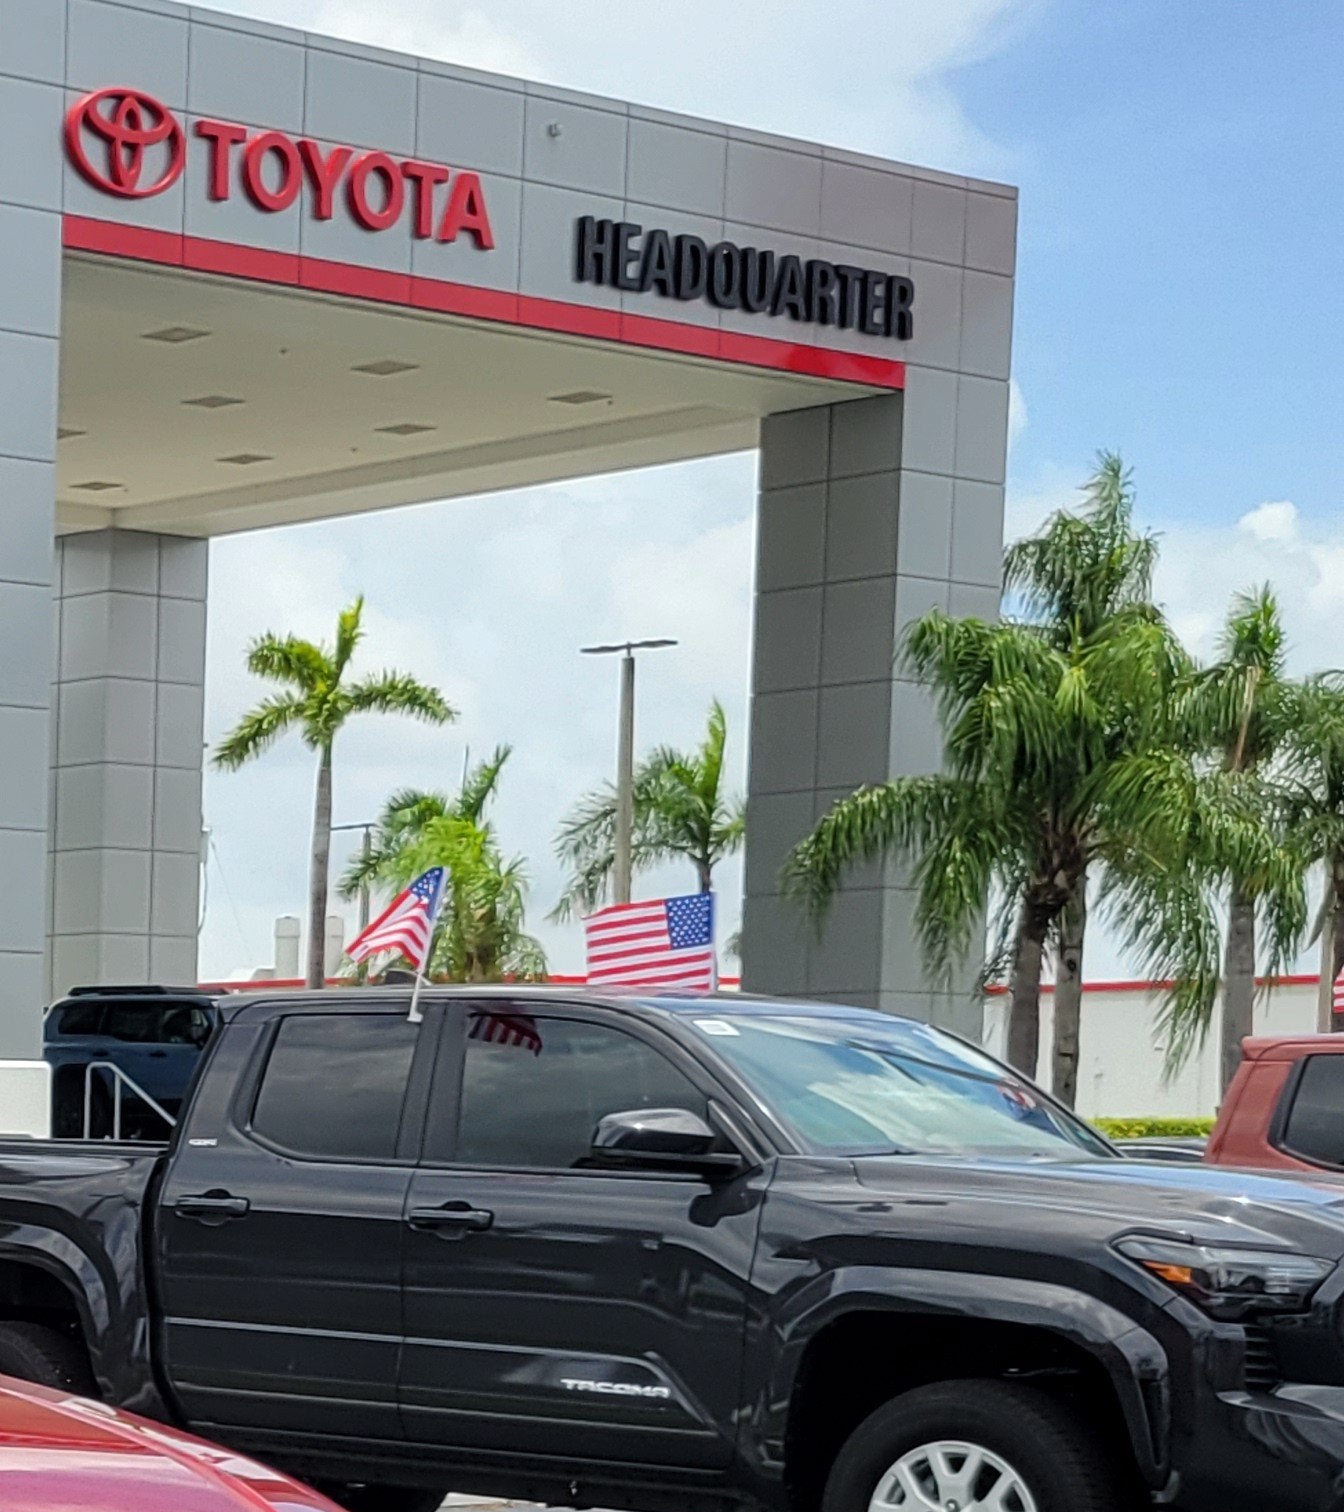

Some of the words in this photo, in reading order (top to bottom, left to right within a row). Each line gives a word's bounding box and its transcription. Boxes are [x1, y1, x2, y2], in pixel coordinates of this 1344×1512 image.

[194, 120, 495, 250] TOYOTA
[572, 215, 915, 341] HEADQUARTER
[561, 1378, 670, 1399] TACOMA
